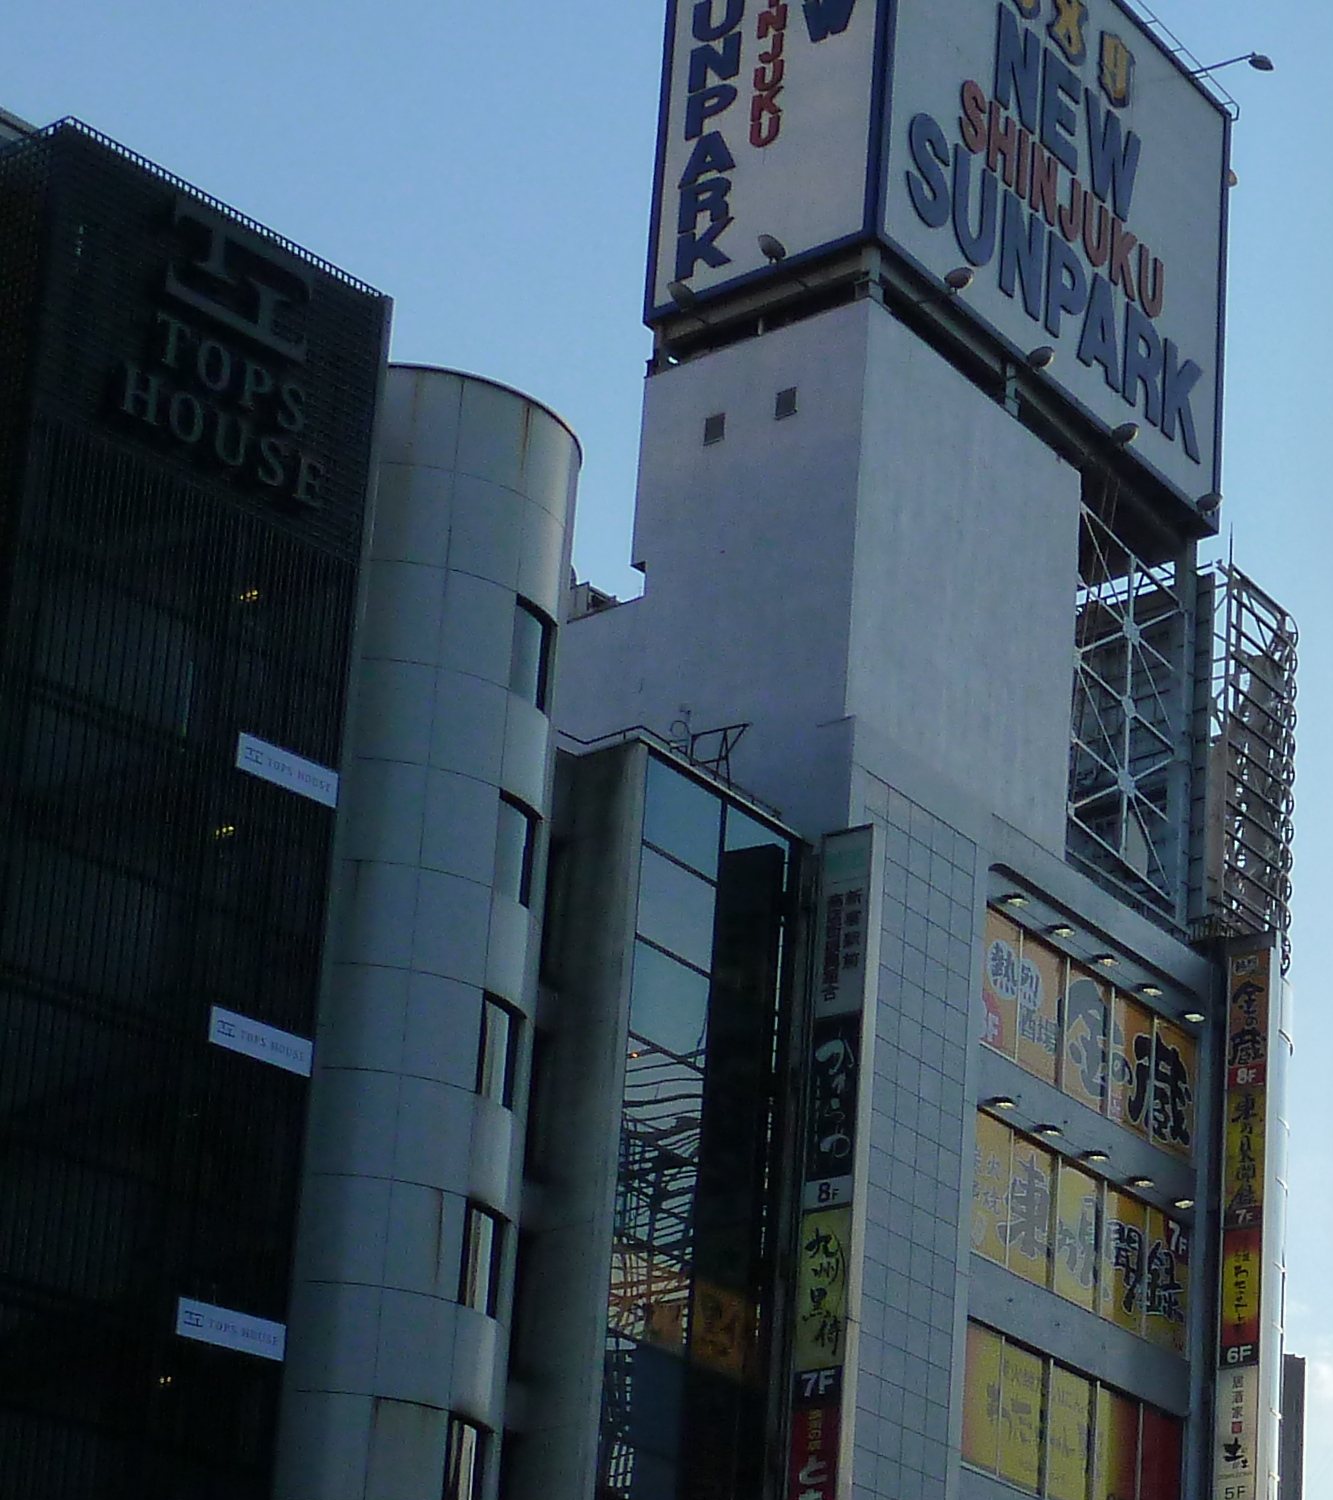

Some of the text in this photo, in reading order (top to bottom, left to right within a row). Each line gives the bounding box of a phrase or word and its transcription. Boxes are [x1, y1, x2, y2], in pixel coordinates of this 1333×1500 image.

[749, 0, 786, 148] NJUKU
[995, 3, 1141, 224] NEW
[959, 79, 1163, 318] SHINJUKU
[906, 112, 1203, 464] SUNPARK
[156, 309, 307, 434] TOPS
[119, 364, 327, 510] HOUSE
[1236, 1066, 1256, 1084] 8F
[817, 1180, 841, 1203] 8F
[801, 1367, 836, 1399] 7F
[1227, 1346, 1252, 1364] 6F
[1224, 1486, 1246, 1500] 5F
